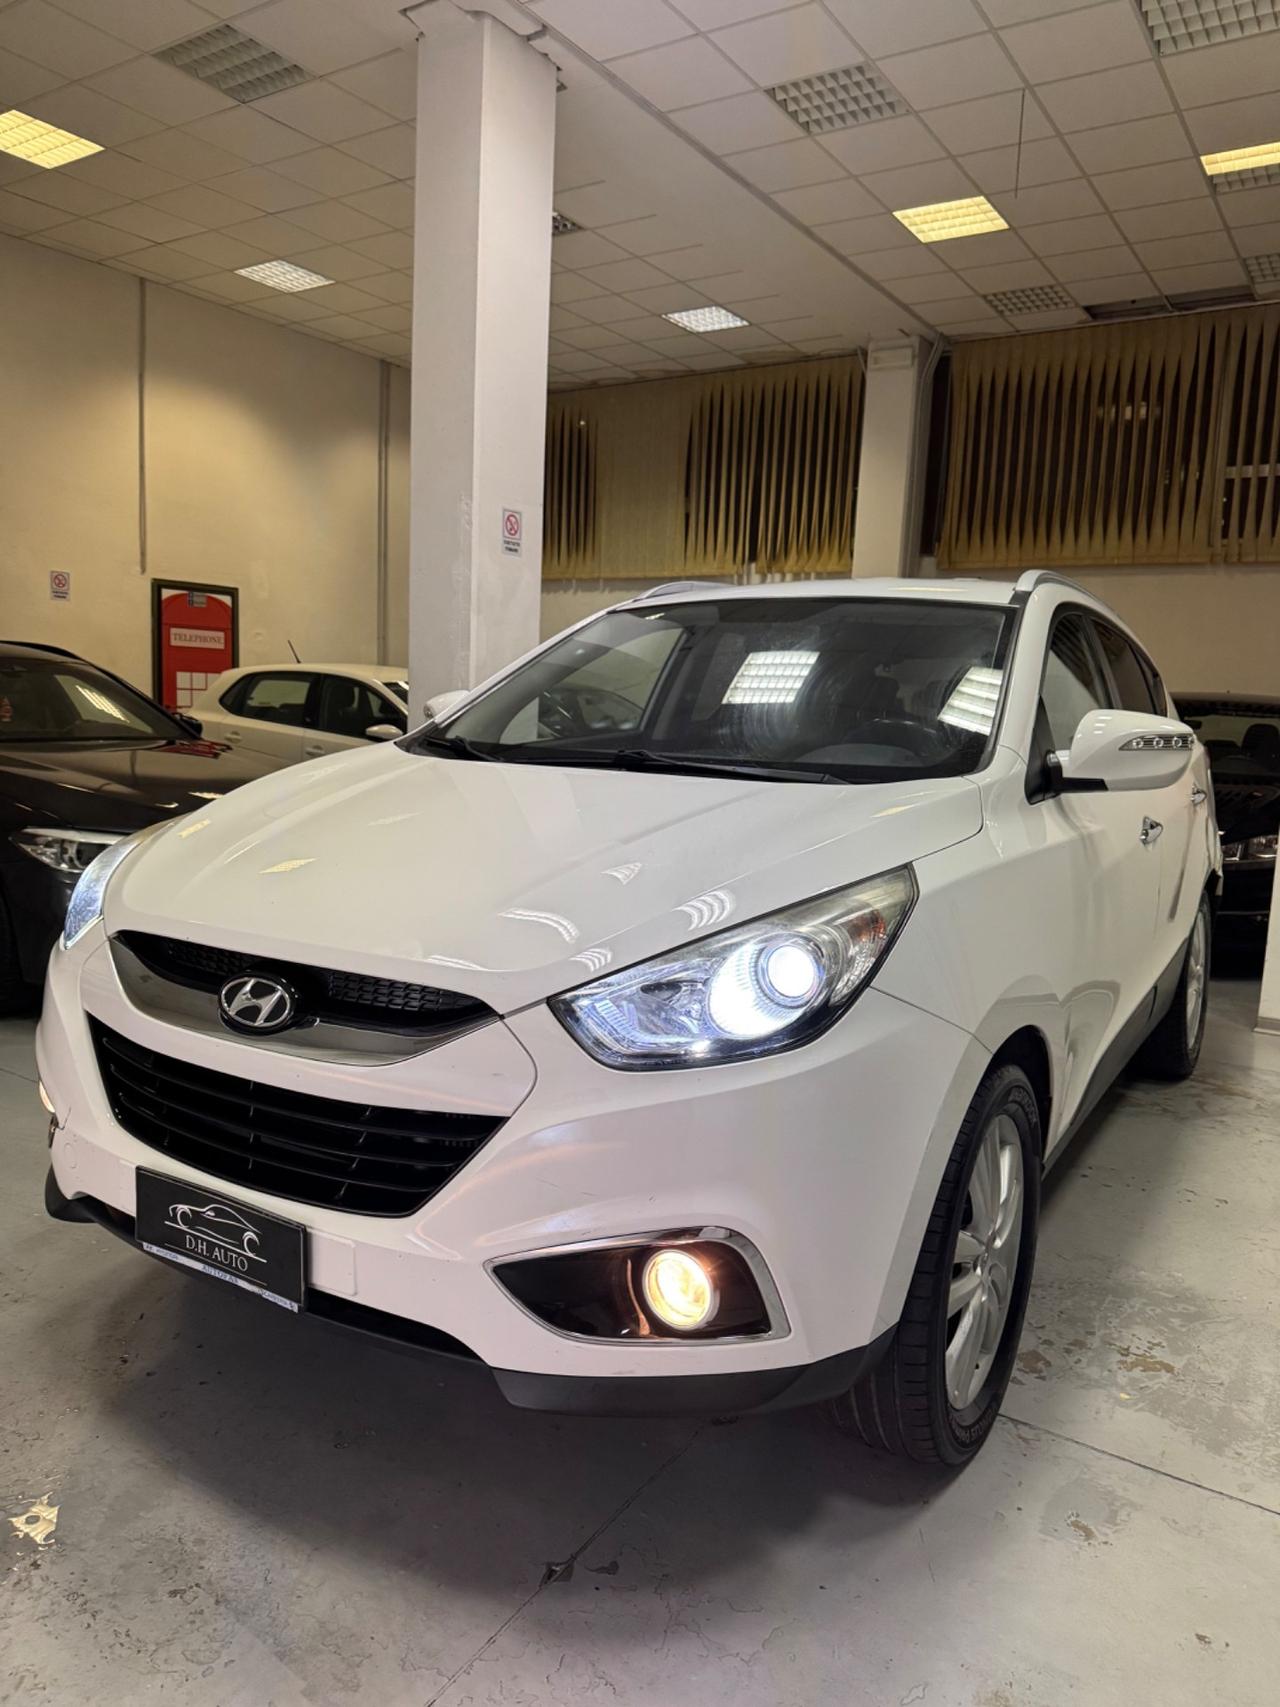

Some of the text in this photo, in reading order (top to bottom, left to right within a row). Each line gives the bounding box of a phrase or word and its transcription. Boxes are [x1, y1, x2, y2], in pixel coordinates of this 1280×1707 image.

[173, 632, 224, 645] TELEPHONE
[186, 1234, 210, 1257] D.H.
[212, 1246, 248, 1272] AUTO
